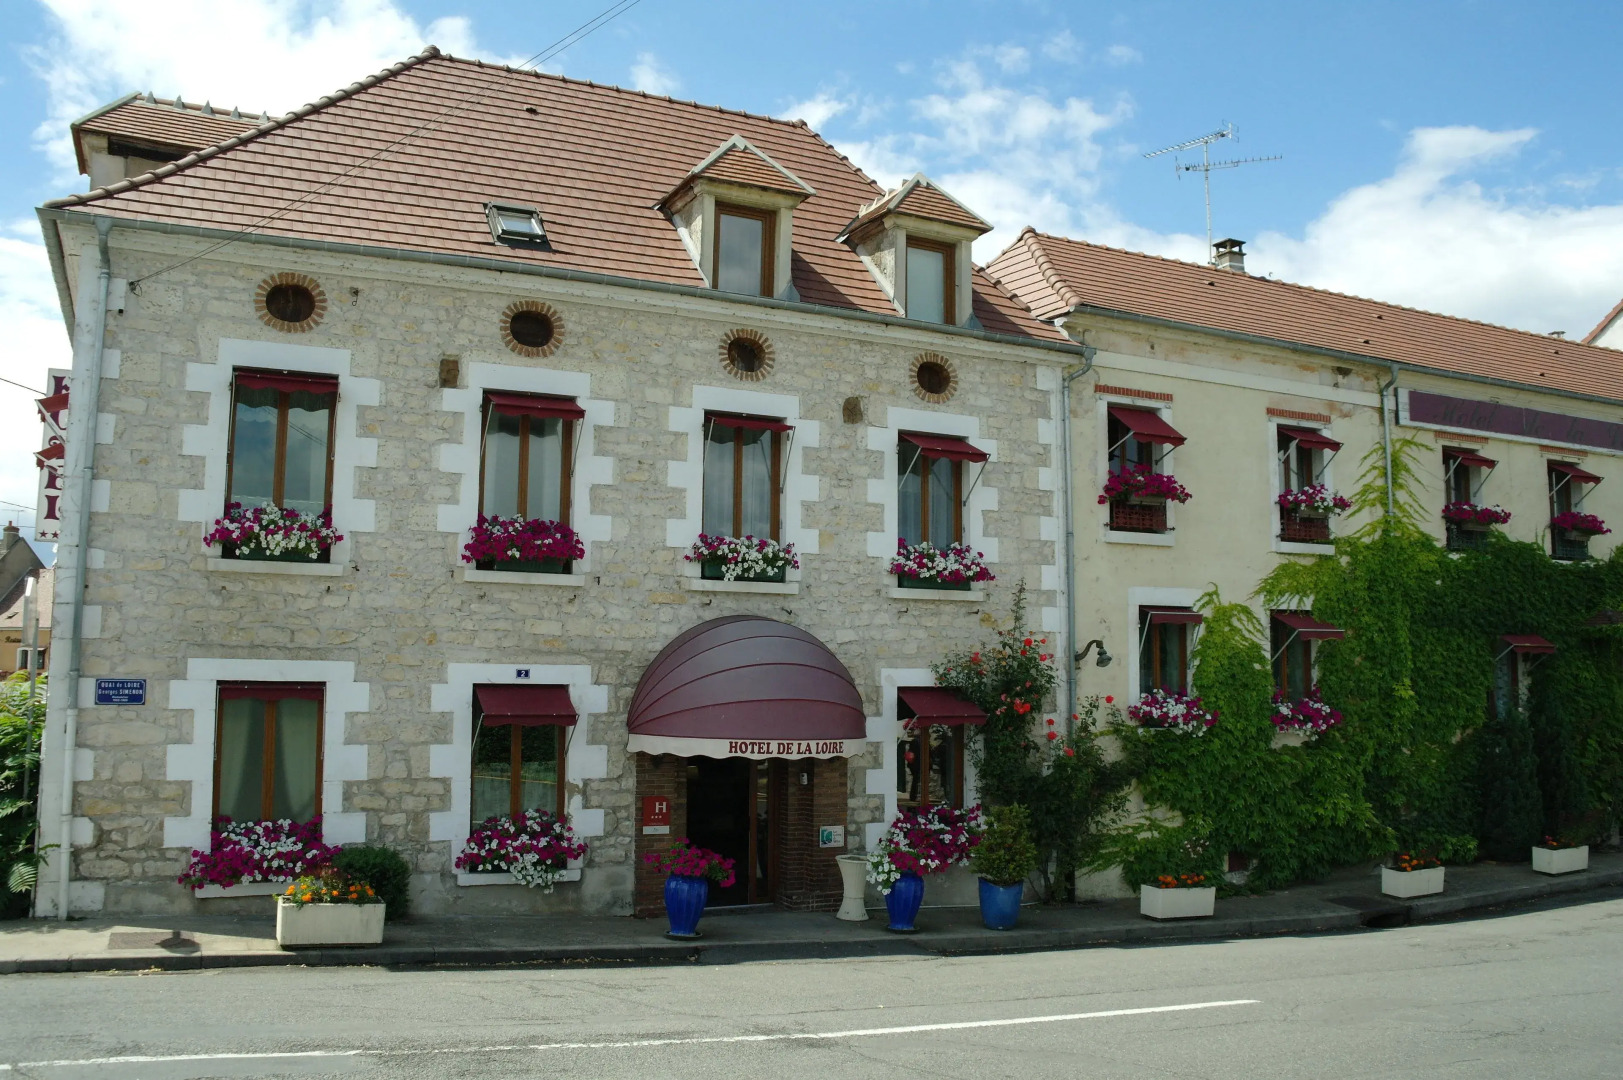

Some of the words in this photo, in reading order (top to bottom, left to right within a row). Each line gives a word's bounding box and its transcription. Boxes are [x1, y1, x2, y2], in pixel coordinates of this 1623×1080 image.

[728, 741, 773, 754] HOTEL
[777, 742, 793, 754] DE
[797, 742, 812, 754] LA
[816, 741, 844, 754] LOIRE
[655, 801, 667, 813] H
